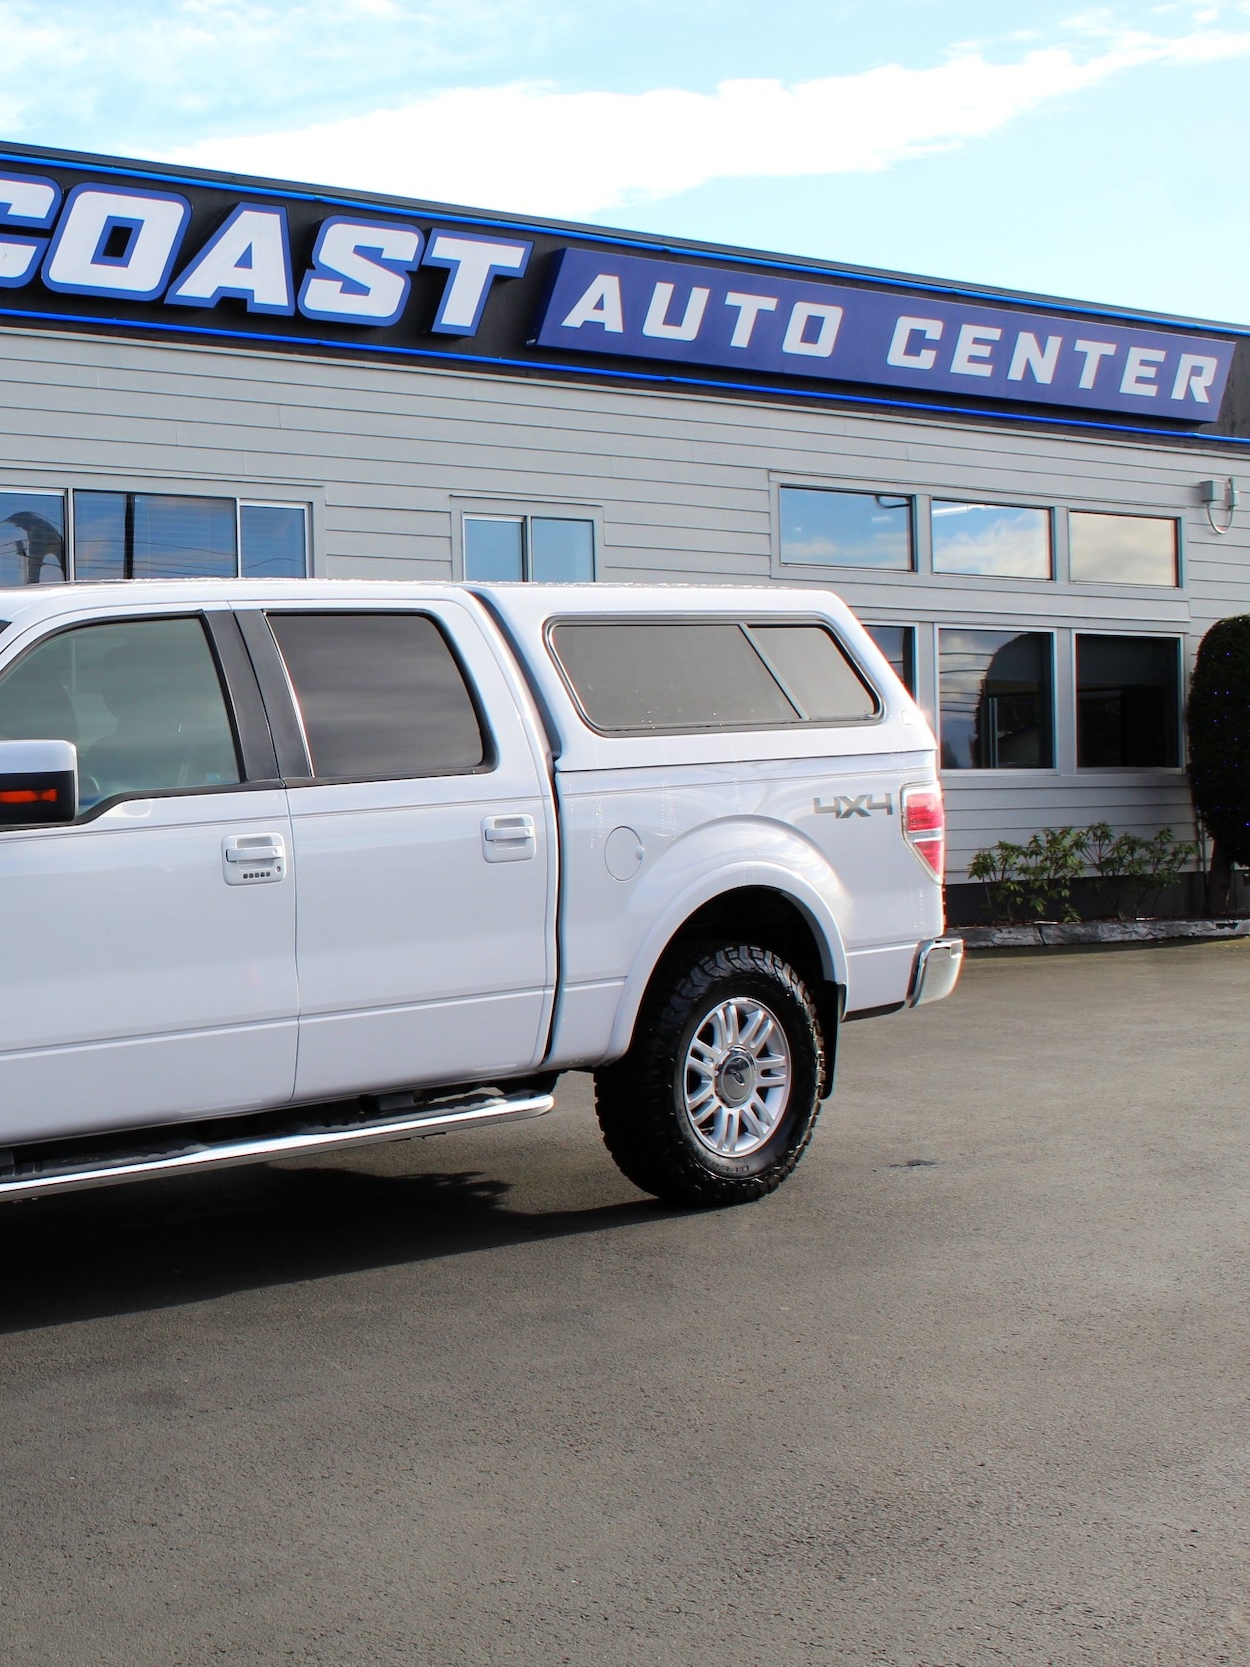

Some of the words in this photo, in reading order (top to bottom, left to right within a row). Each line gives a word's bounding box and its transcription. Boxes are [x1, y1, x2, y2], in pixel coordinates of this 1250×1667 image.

[562, 274, 843, 357] AUTO
[887, 315, 1218, 404] CENTER
[813, 793, 893, 819] 4X4
